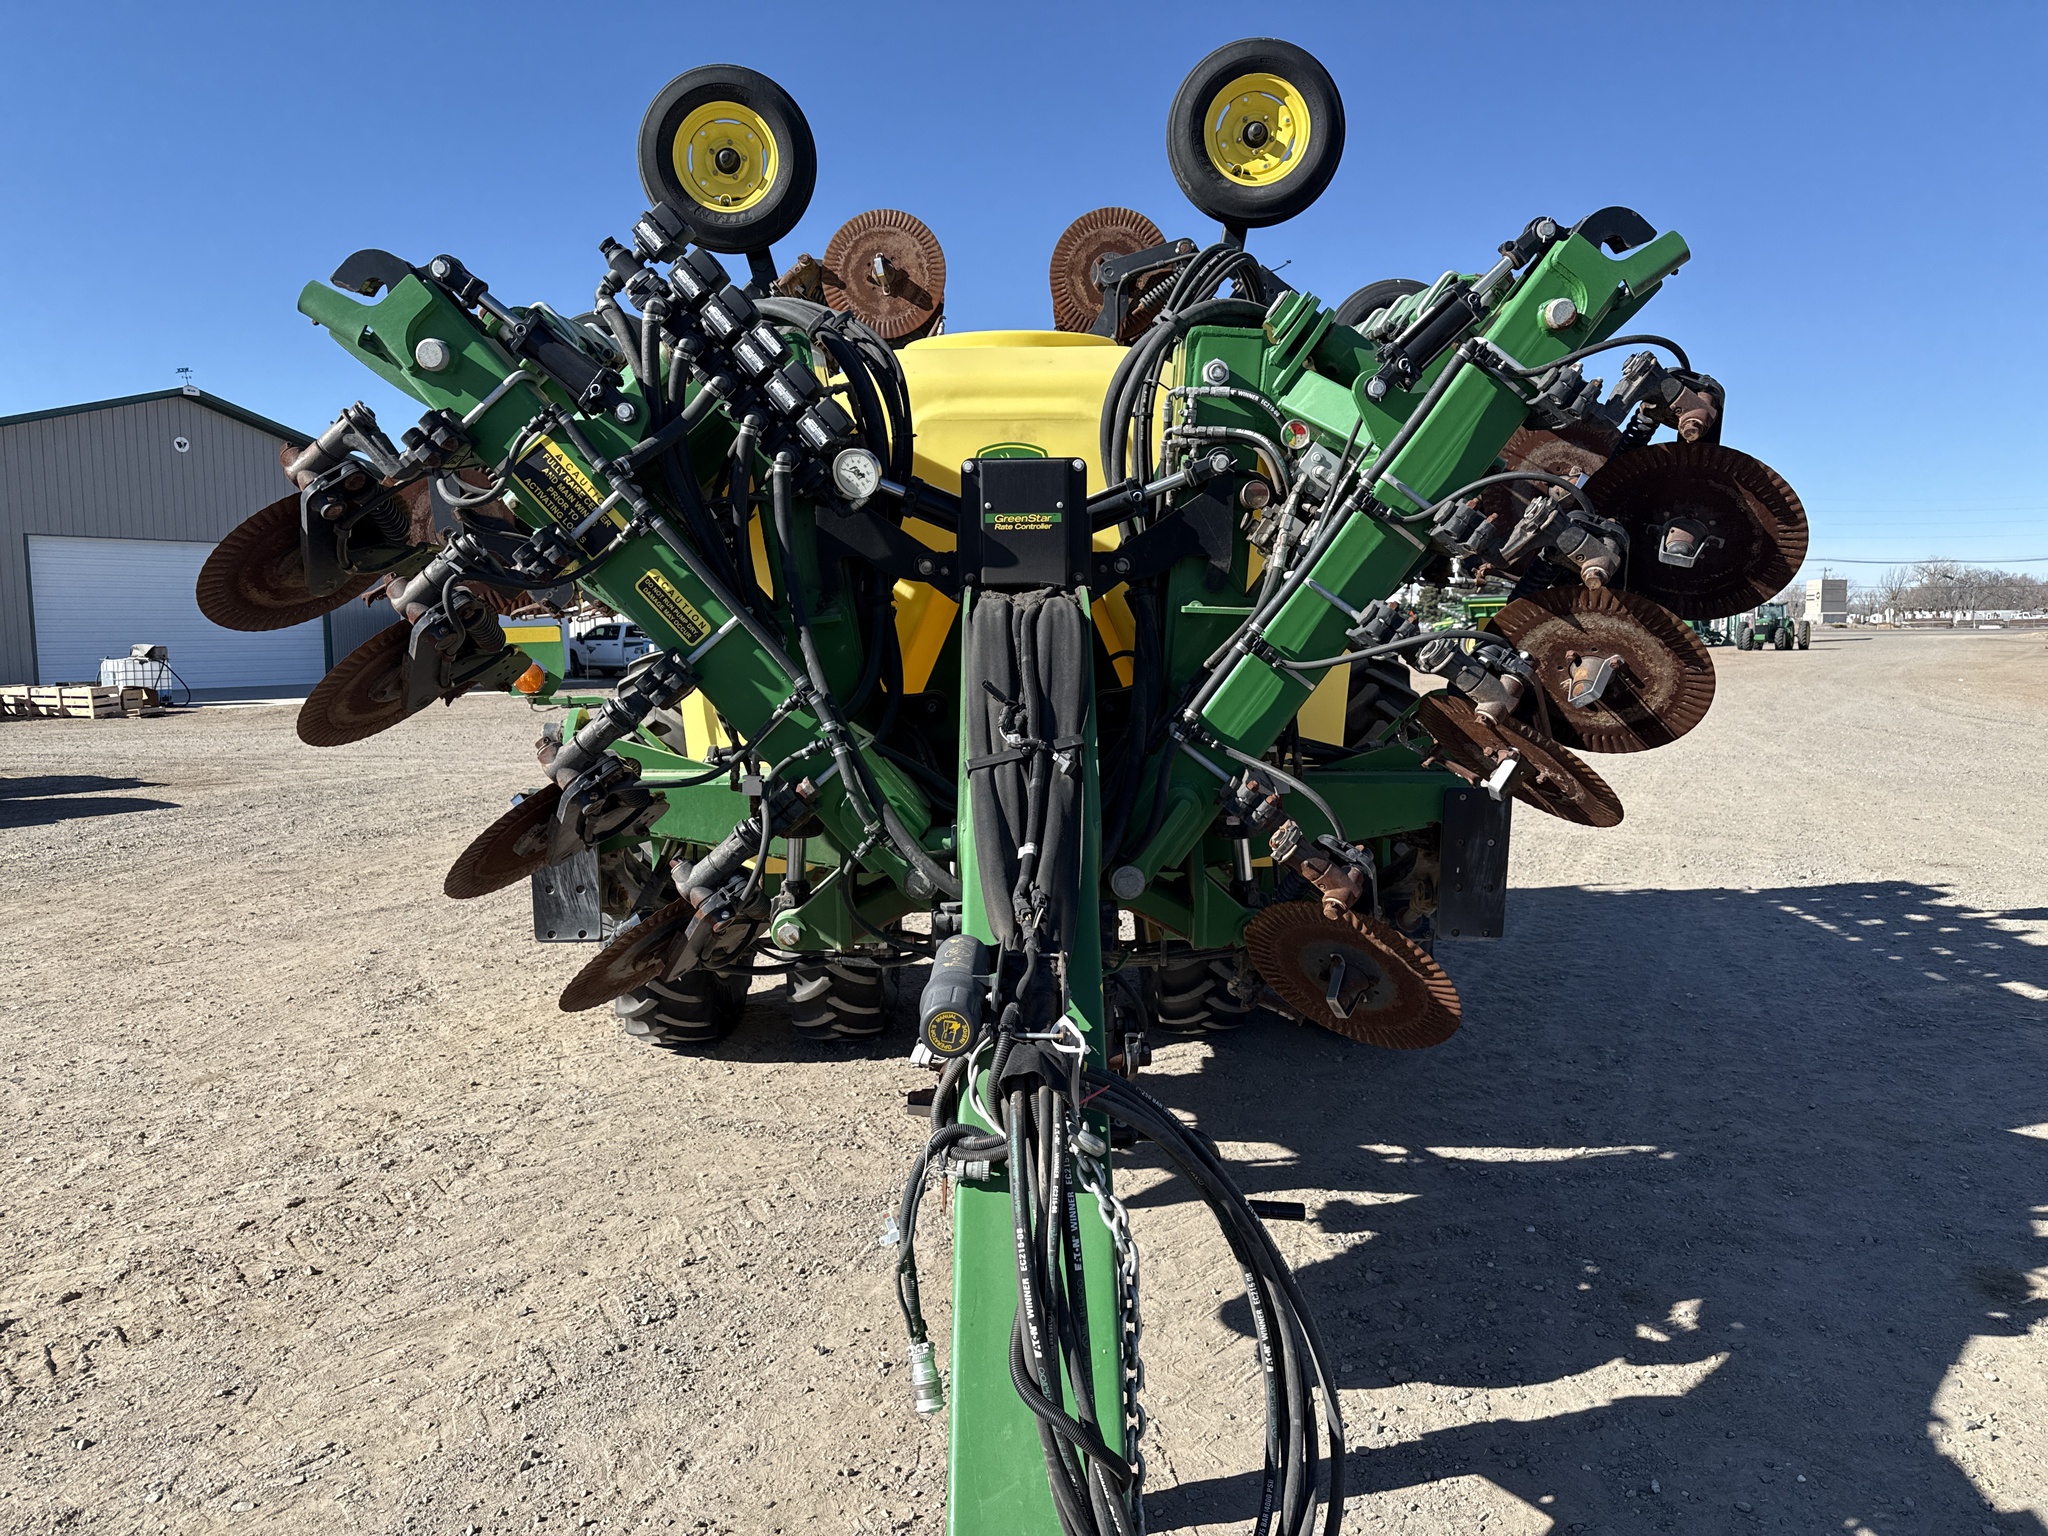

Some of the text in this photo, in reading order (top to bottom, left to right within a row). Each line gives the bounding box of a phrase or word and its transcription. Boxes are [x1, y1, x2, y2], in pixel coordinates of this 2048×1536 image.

[1238, 390, 1259, 401] WINNER
[542, 452, 566, 477] FULLY
[562, 475, 586, 499] RAISE
[565, 463, 606, 507] CAUTIO
[524, 477, 587, 544] ACTIVATING LOCS
[541, 467, 598, 527] AND MAIN WINS
[546, 486, 579, 521] PRIOR TO
[994, 513, 1053, 523] GreenStar
[994, 523, 1014, 531] Rate
[642, 587, 693, 639] DAMAGE MAY OCCUR
[644, 578, 654, 589] DO
[652, 587, 665, 599] NOT
[663, 597, 676, 610] RUN
[673, 608, 689, 624] PUMP
[661, 581, 707, 630] CAUTION
[935, 1013, 957, 1023] MANUAL
[958, 1024, 968, 1044] INSIDE
[1067, 1191, 1078, 1232] WINNER
[1016, 1227, 1028, 1272] EC215-08
[1022, 1278, 1035, 1319] WINNER
[1256, 1308, 1269, 1341] WINNER
[1260, 1513, 1270, 1528] BAR
